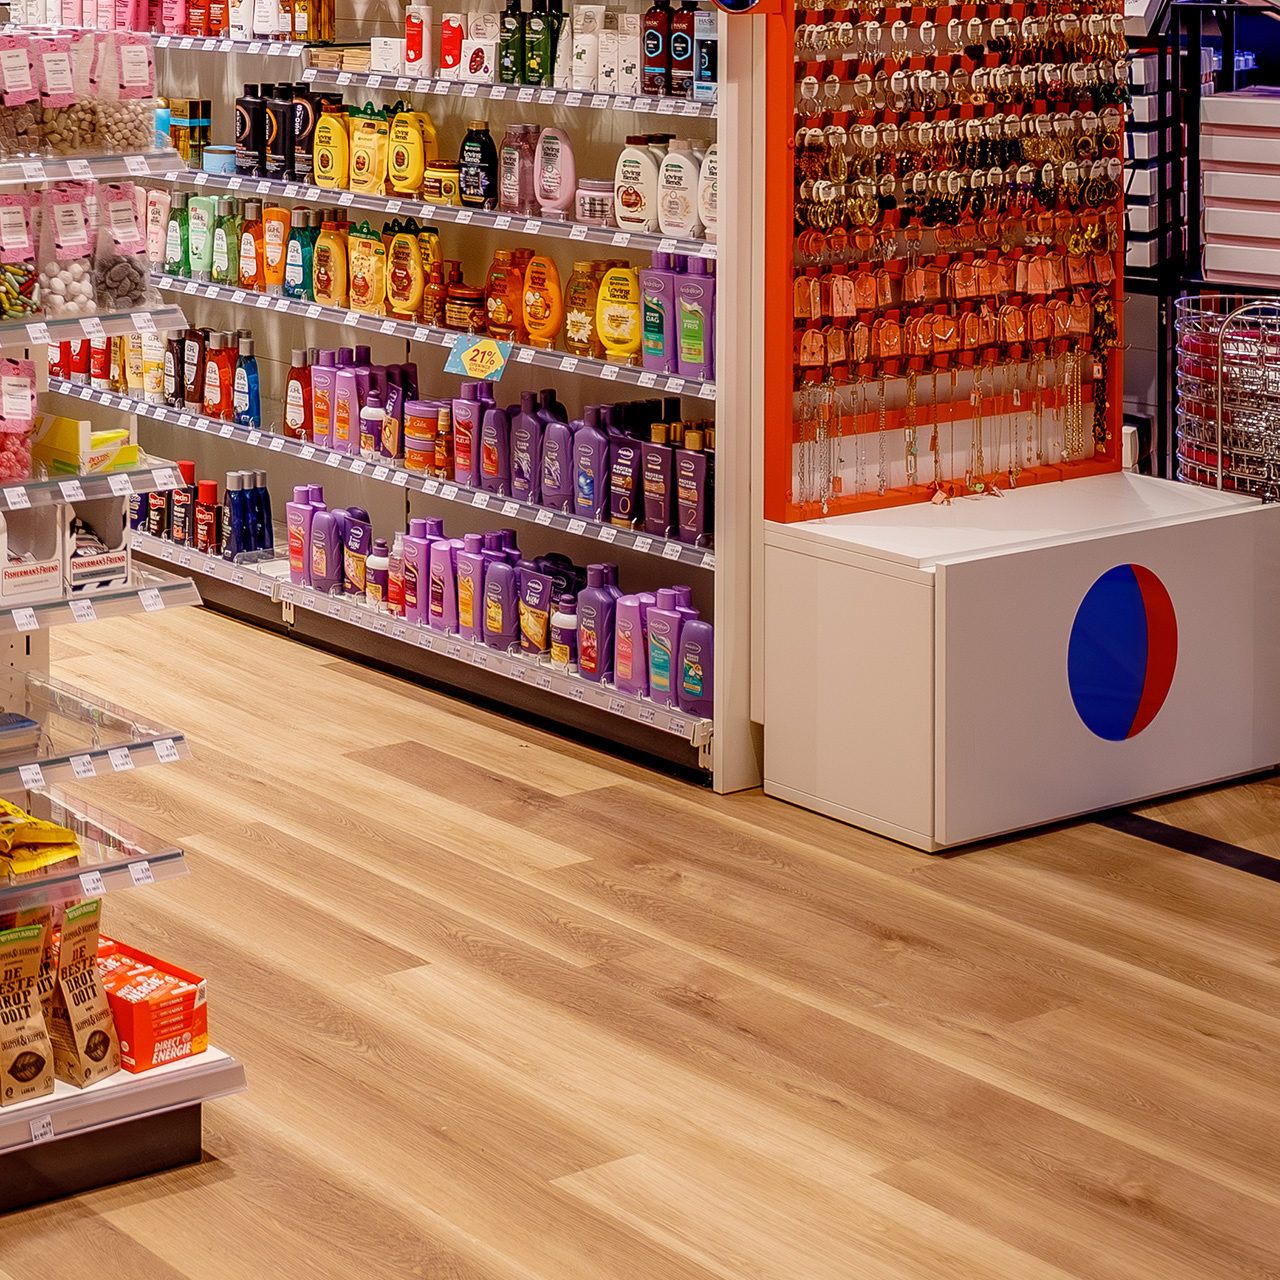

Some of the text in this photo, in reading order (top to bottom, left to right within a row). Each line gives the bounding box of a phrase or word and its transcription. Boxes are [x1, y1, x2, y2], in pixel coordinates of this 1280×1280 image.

[607, 287, 630, 296] Loving
[645, 315, 660, 324] DAG
[683, 322, 699, 330] FRIS
[468, 348, 496, 366] 21%
[687, 509, 697, 526] 2
[72, 554, 125, 570] FISHERMAN'S FRIEND
[4, 564, 58, 580] FISHERMAN'S FRIEND
[72, 945, 87, 961] DE
[3, 967, 22, 981] DE
[60, 955, 96, 981] BESTE
[65, 970, 95, 993] DROP
[72, 985, 97, 1008] OOIT
[0, 1005, 31, 1026] OOIT
[154, 1035, 181, 1052] DIRECT
[151, 1041, 193, 1064] ENERGIE
